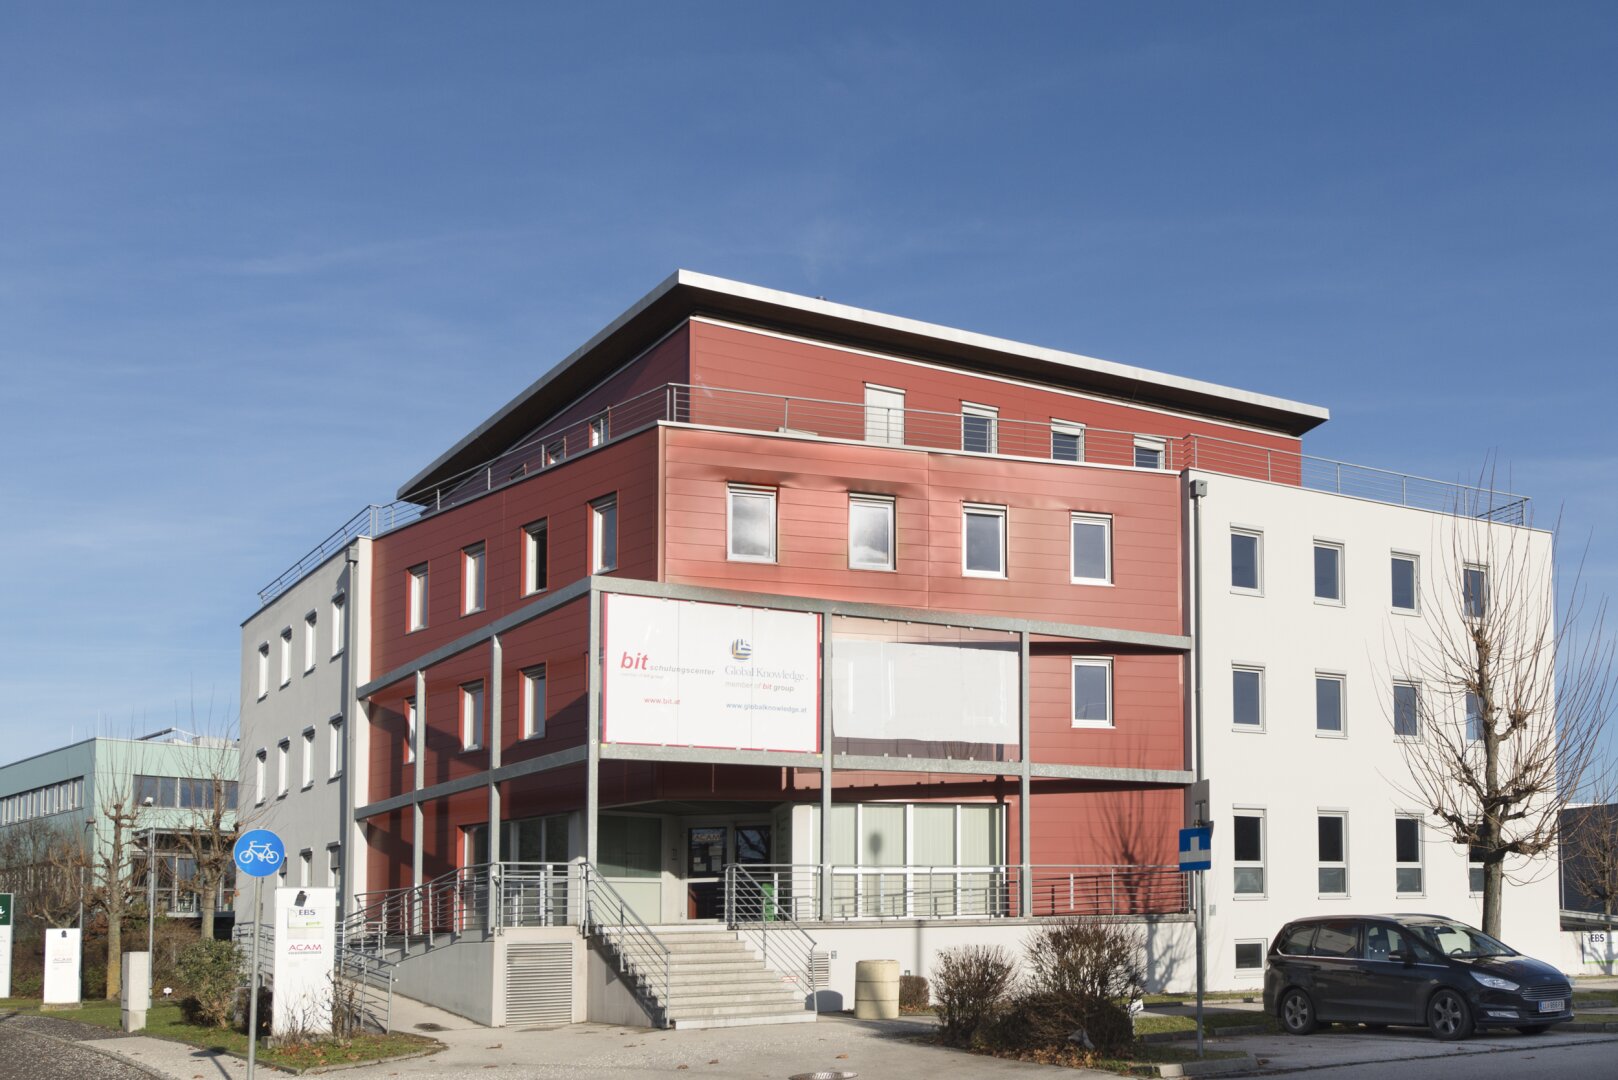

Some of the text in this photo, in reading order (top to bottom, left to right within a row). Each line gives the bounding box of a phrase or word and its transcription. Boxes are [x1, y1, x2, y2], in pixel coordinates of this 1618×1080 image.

[620, 651, 715, 675] bit schulungscenter
[725, 665, 804, 683] Global Knowledge
[725, 681, 752, 689] member
[644, 697, 680, 705] www.bit.at
[726, 702, 807, 714] www.globalknowledge.at
[1591, 934, 1604, 942] EBS
